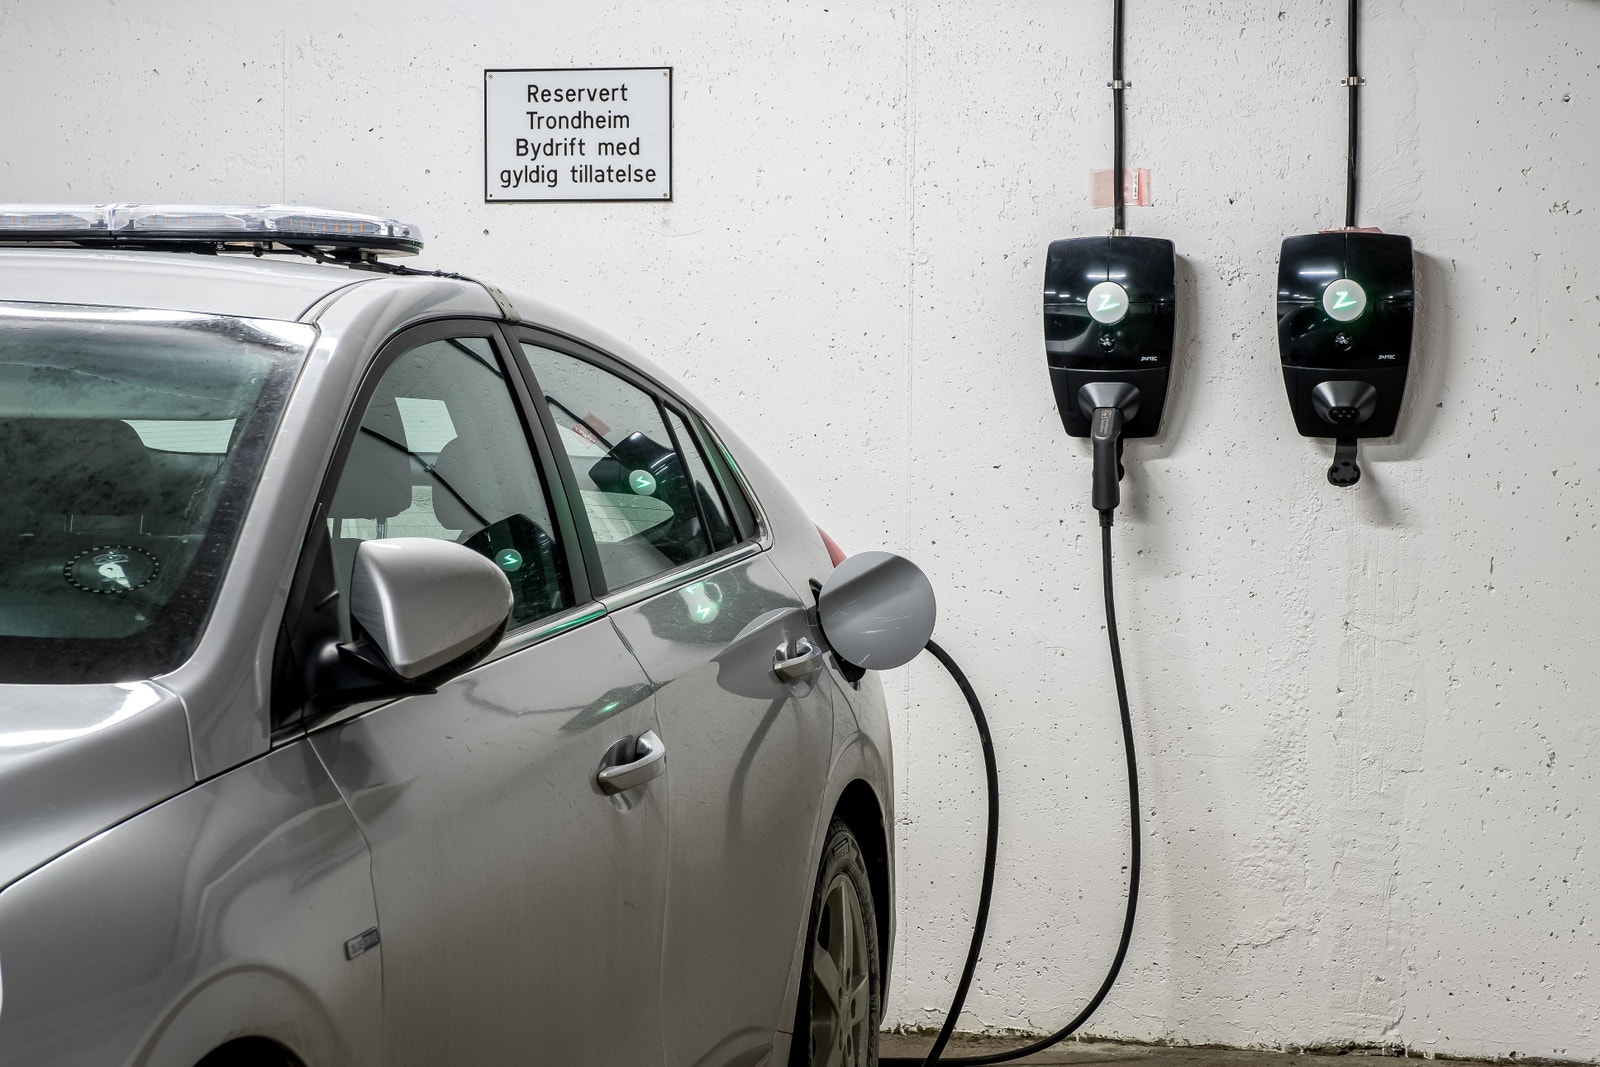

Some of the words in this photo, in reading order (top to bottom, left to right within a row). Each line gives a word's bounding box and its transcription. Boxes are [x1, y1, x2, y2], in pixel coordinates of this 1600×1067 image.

[527, 84, 628, 102] Reservert
[526, 110, 629, 129] Trondheim
[516, 138, 585, 161] Bydrift
[598, 137, 640, 156] med
[500, 165, 557, 188] gyldig
[570, 164, 657, 183] tillatelse
